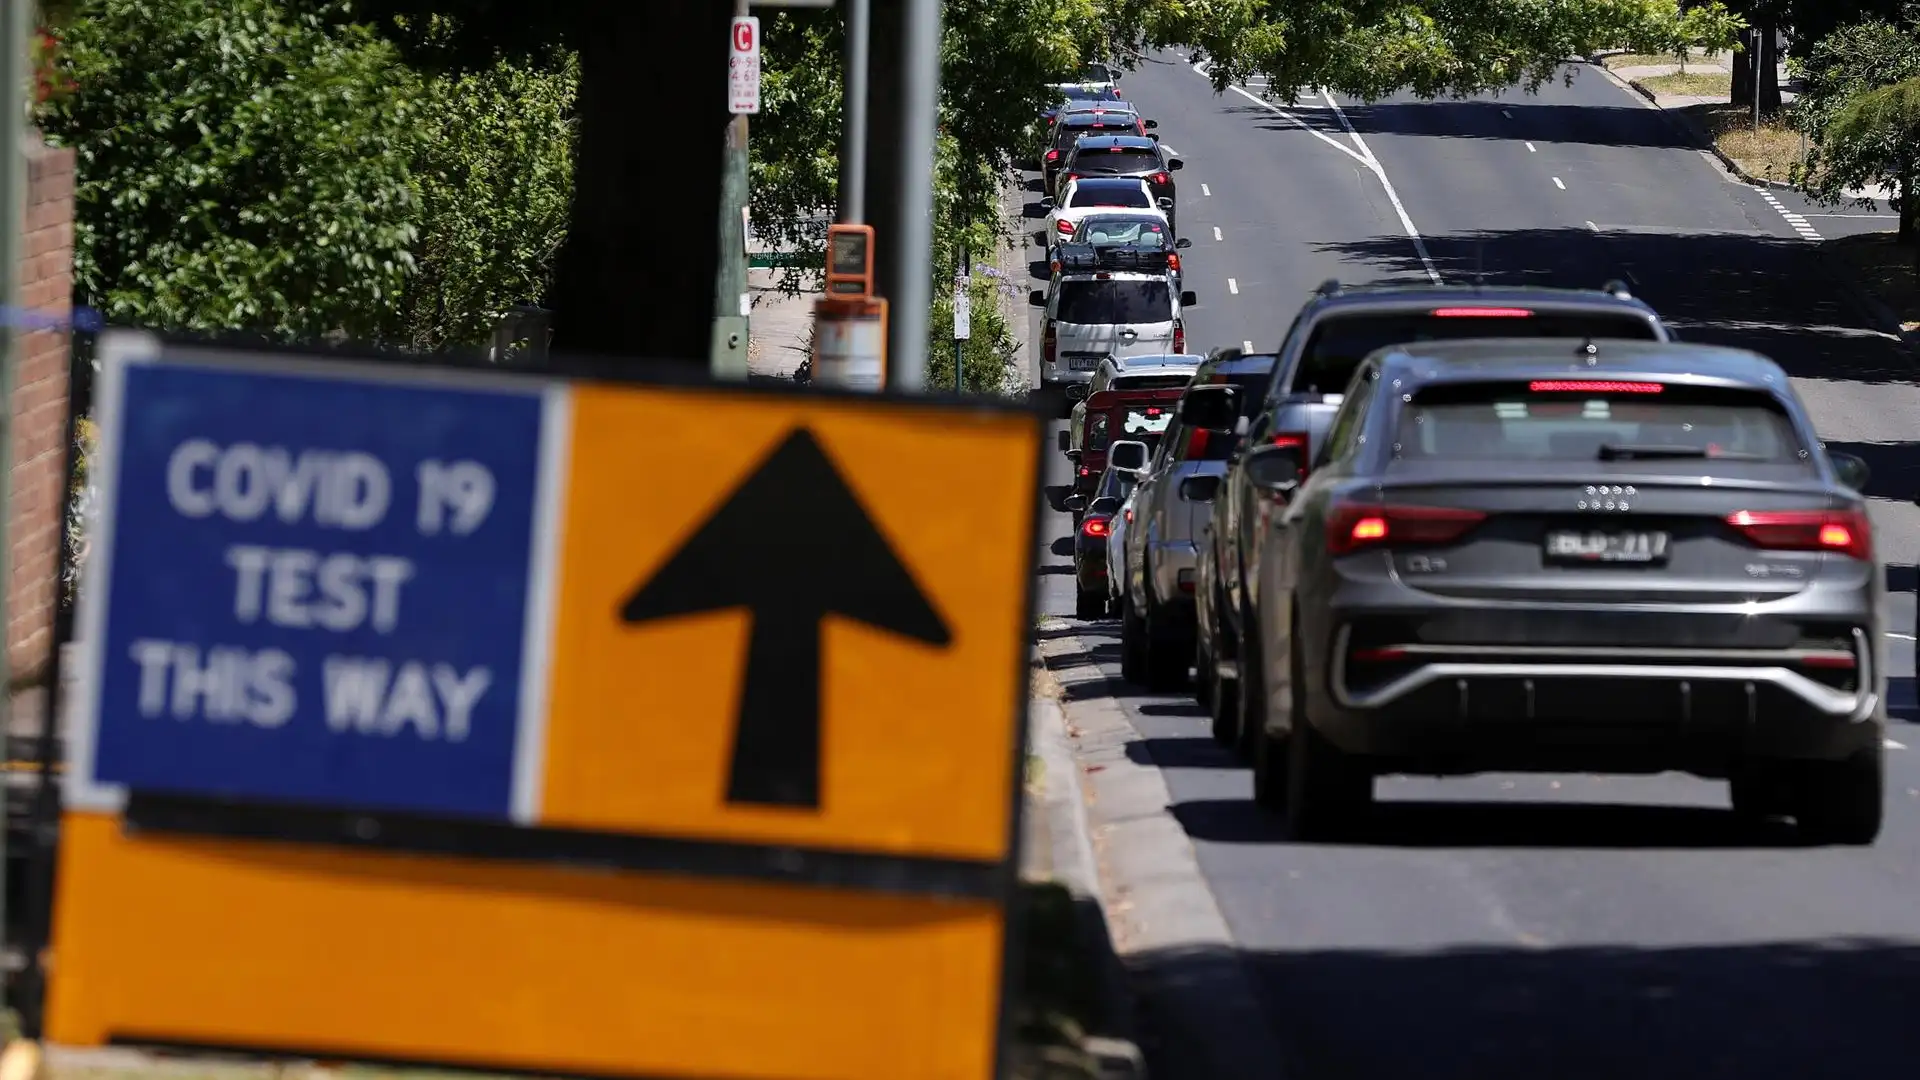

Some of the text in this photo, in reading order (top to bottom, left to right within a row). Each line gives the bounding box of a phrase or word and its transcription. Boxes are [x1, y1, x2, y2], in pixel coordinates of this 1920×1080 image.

[738, 24, 750, 50] C
[168, 438, 496, 534] COVID 19
[225, 544, 415, 634] TEST
[130, 639, 491, 742] THIS WAY
